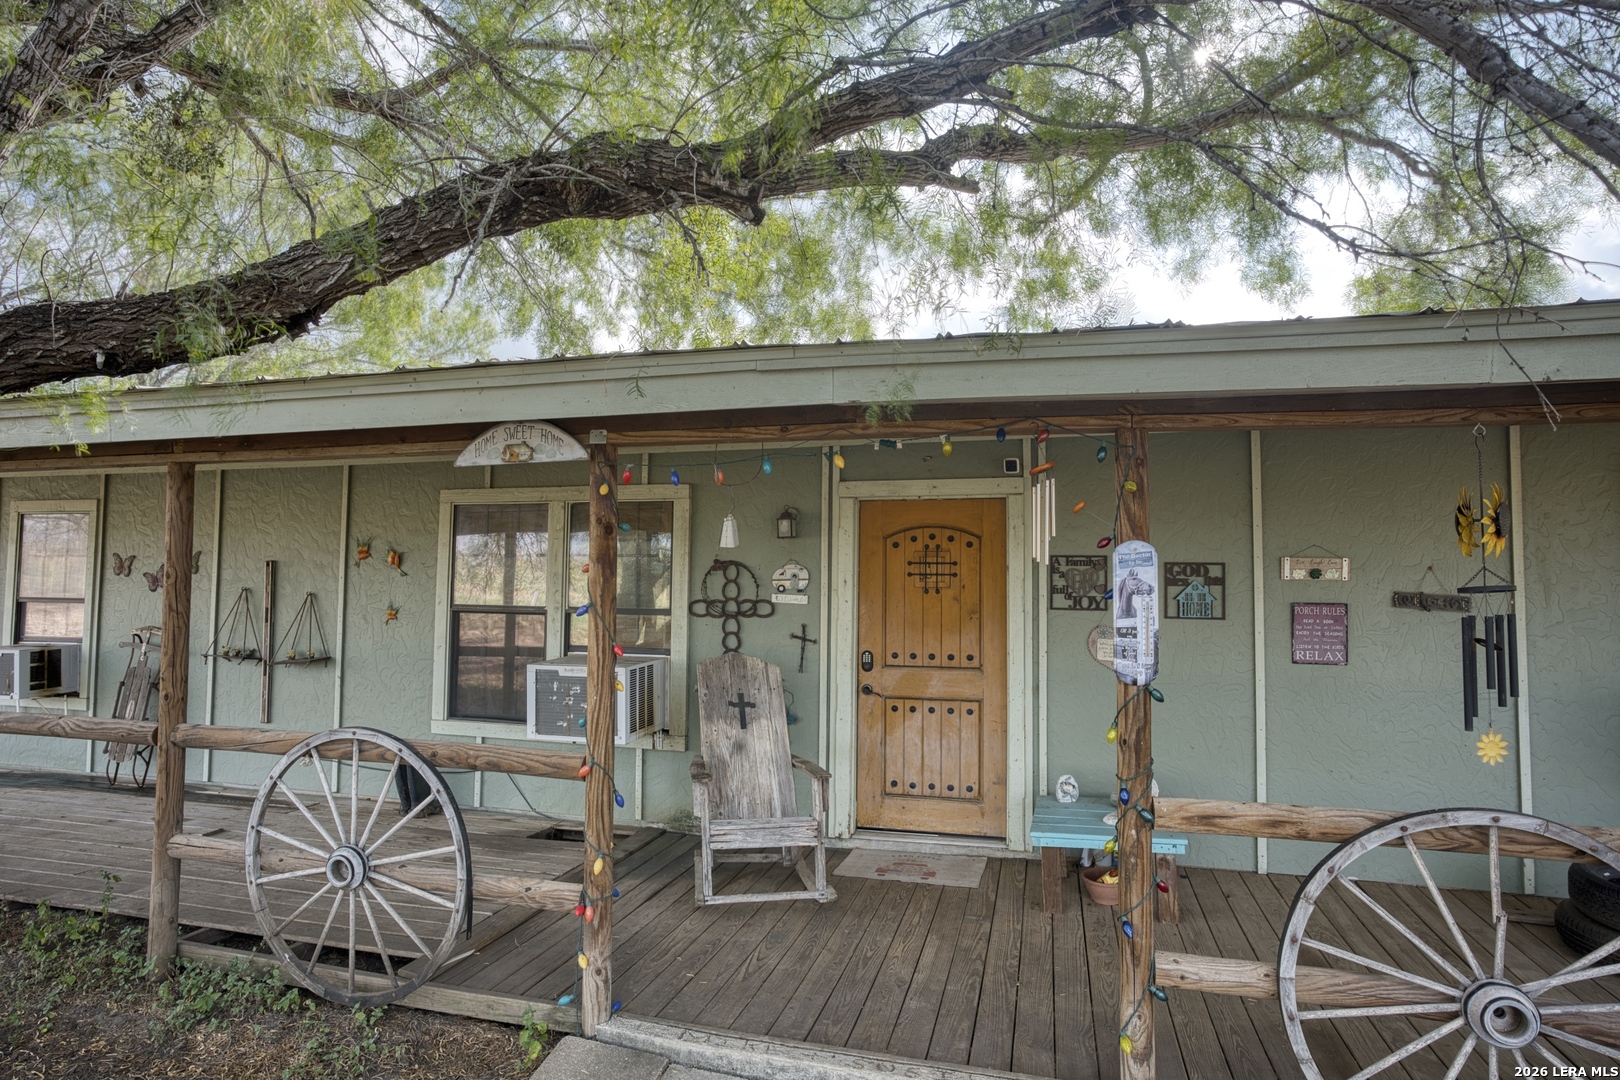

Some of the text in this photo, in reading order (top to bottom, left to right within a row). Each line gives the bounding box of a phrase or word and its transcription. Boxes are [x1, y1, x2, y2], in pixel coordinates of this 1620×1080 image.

[474, 424, 565, 458] HOME SWEET HOME
[1053, 557, 1062, 566] A
[1167, 563, 1210, 578] GOD
[1068, 596, 1105, 609] JOY
[1181, 601, 1210, 617] HOME
[1294, 606, 1346, 616] PORCH RULES
[1295, 650, 1344, 661] RELAX
